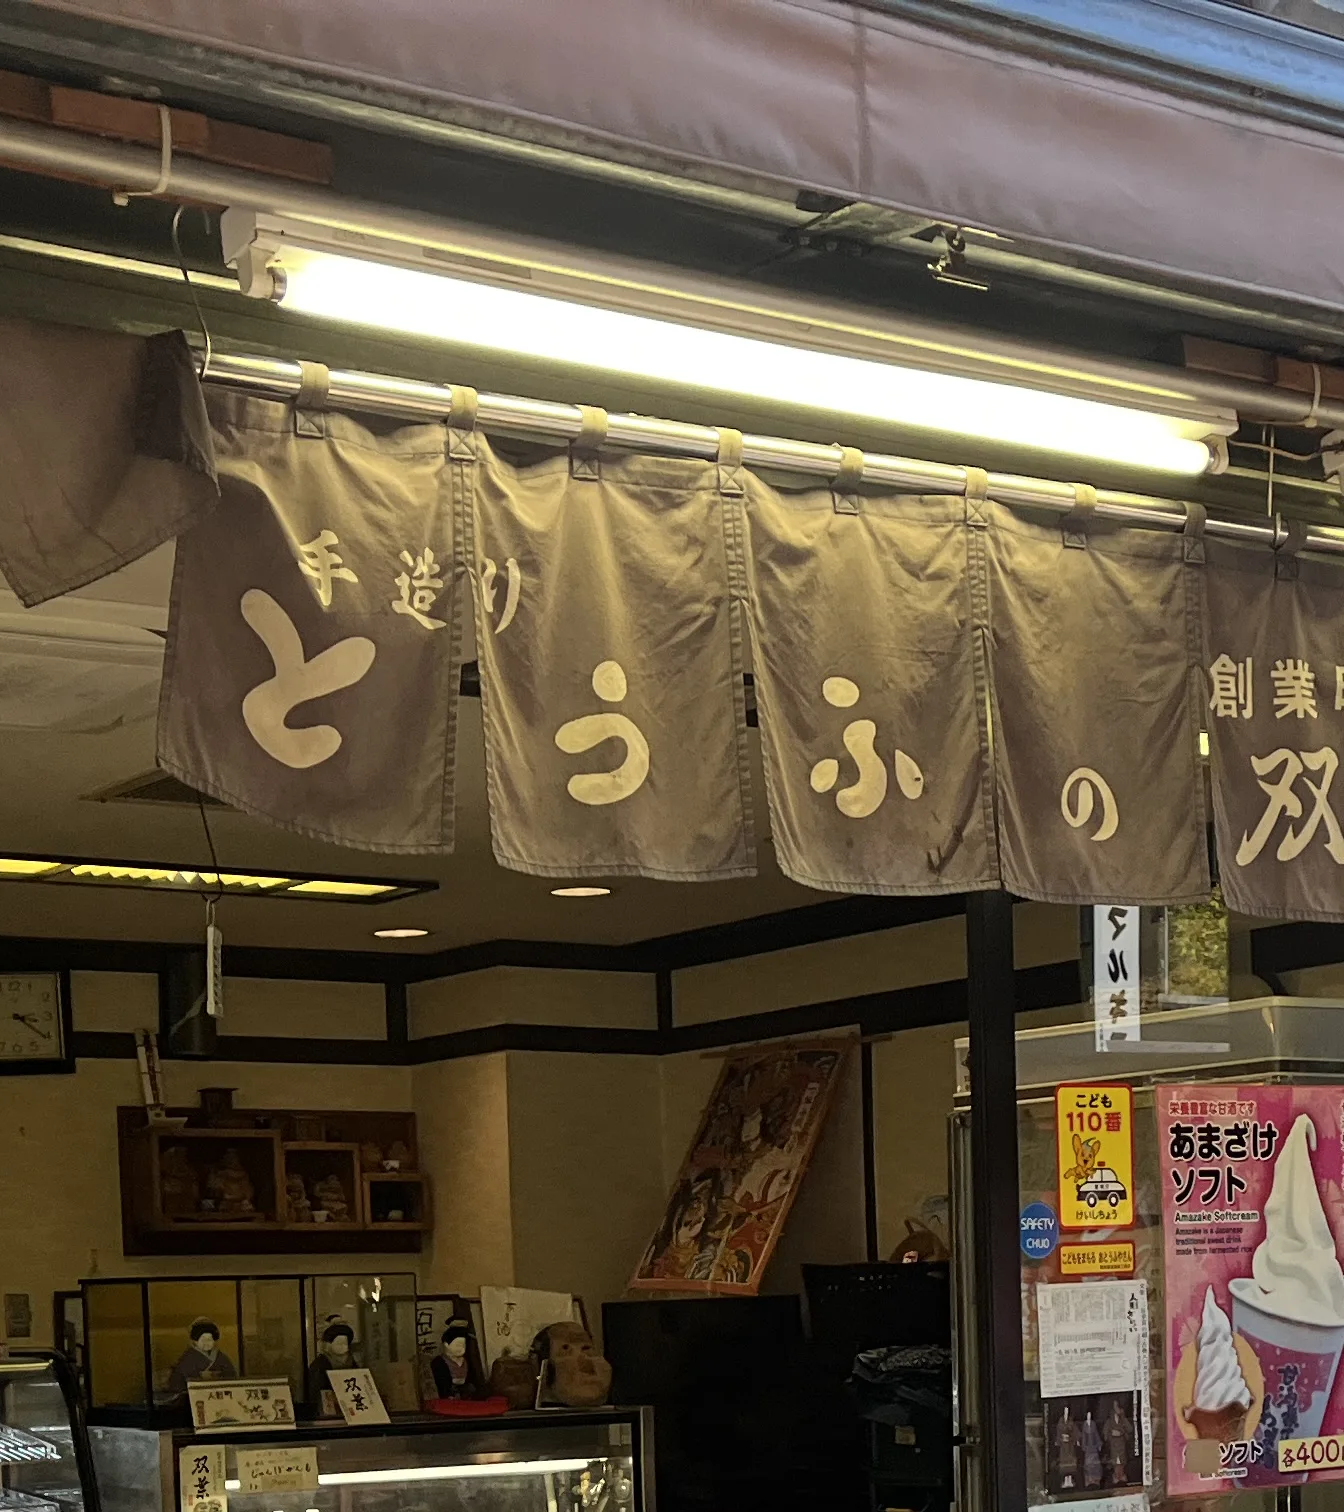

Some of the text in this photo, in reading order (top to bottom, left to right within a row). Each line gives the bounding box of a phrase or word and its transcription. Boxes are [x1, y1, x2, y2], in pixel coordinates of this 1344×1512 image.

[297, 530, 520, 633] 手造り
[1075, 1093, 1113, 1109] こども
[1066, 1111, 1122, 1134] 110番
[1168, 1122, 1278, 1162] あまざけ
[1171, 1167, 1247, 1207] ソフト
[1020, 1216, 1054, 1231] SAFETY
[191, 1455, 210, 1500] 双葉
